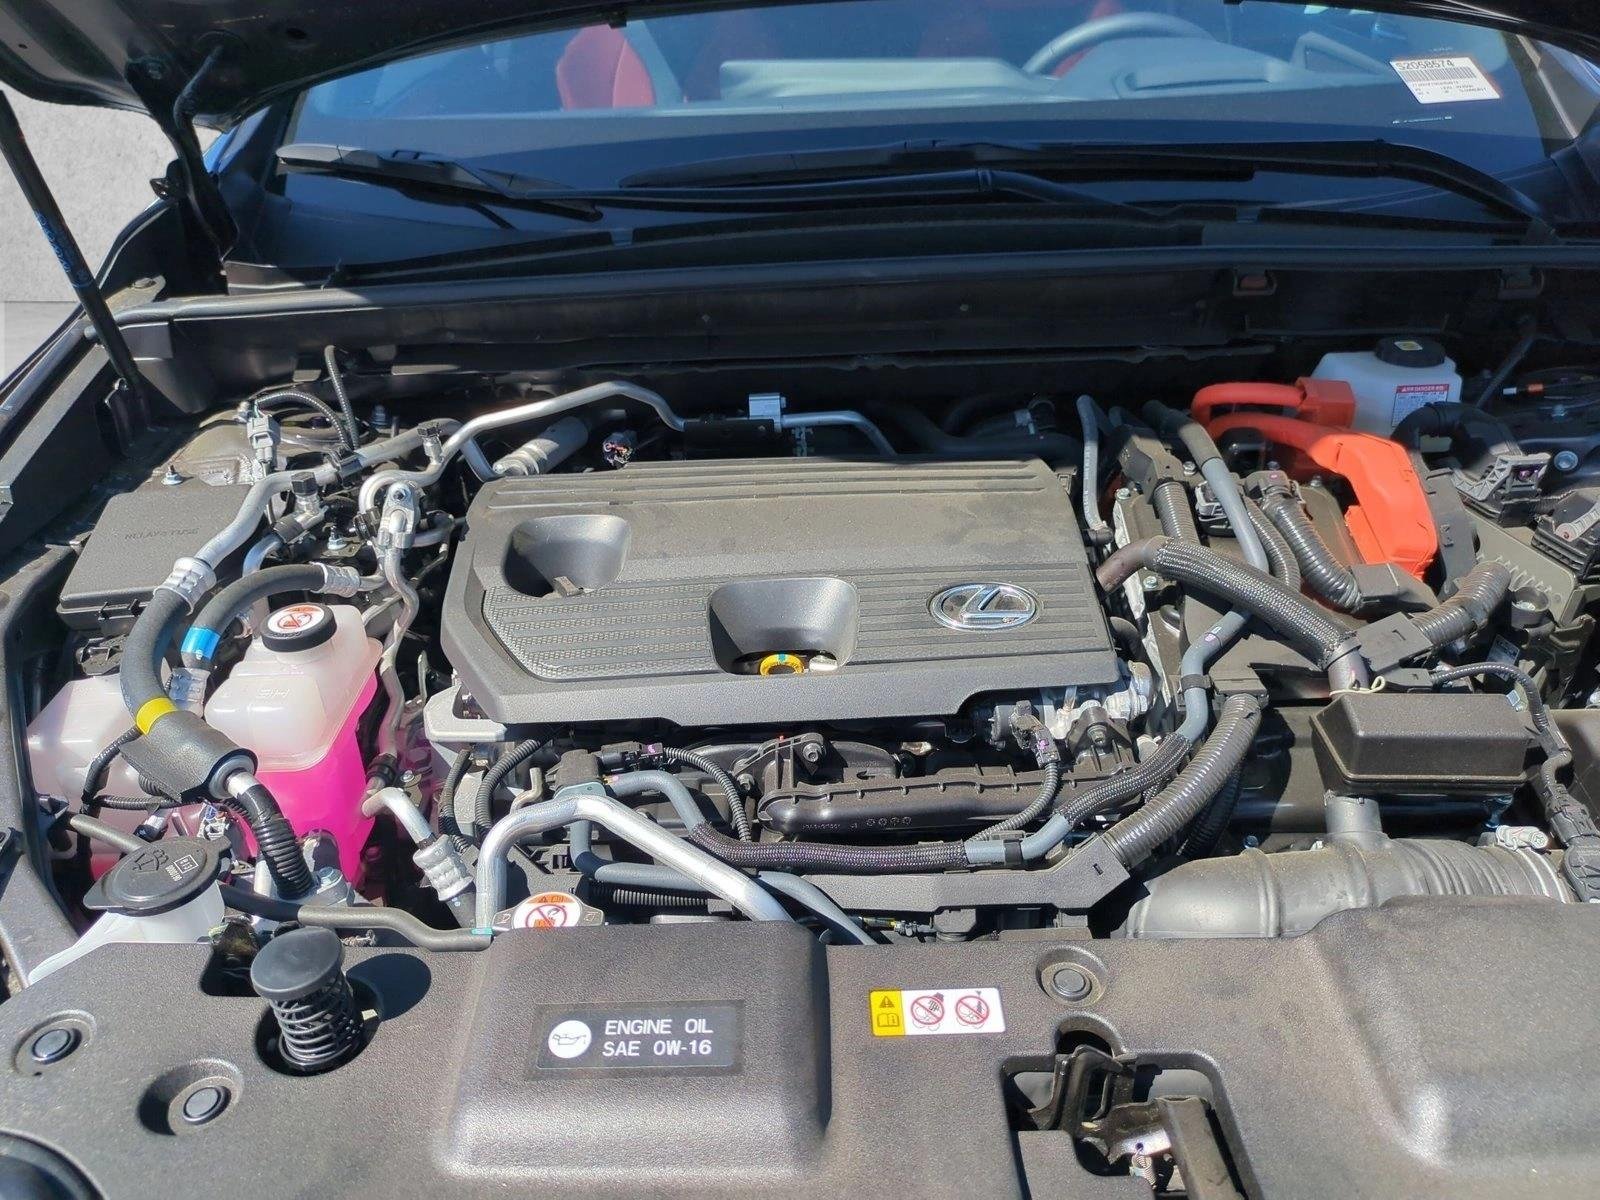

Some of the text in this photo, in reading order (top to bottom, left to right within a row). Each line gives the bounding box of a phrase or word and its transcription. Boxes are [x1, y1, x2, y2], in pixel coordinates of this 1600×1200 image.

[604, 1018, 714, 1035] ENGINE OIL
[602, 1039, 713, 1057] SAE 0W-16
